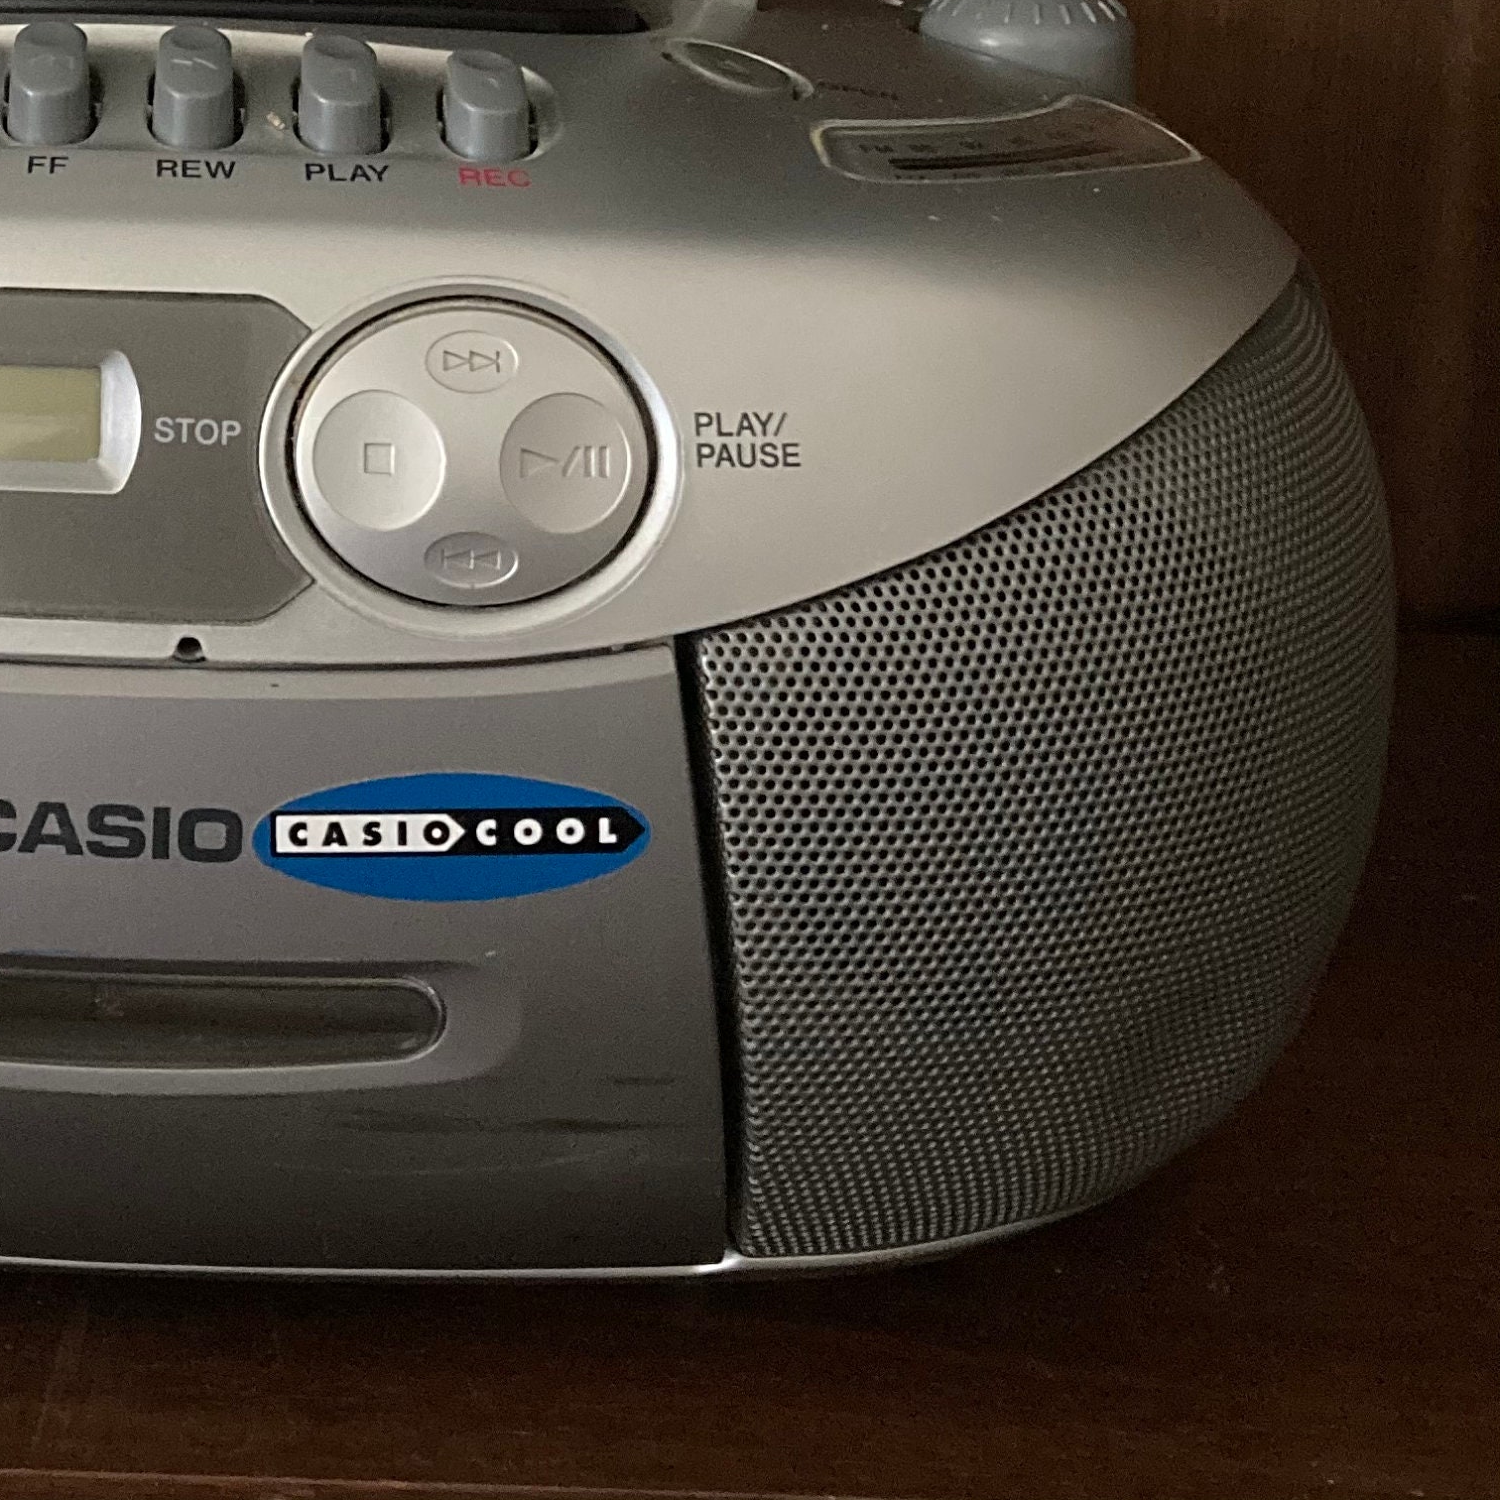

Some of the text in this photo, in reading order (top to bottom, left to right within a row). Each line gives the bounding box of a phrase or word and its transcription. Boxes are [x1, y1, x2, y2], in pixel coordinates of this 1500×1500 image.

[27, 156, 69, 174] FF
[155, 159, 236, 179] REW
[305, 163, 390, 182] PLAY
[458, 167, 532, 188] REC
[153, 416, 242, 446] STOP
[694, 411, 787, 438] PLAY/
[697, 442, 802, 469] PAUSE
[288, 817, 617, 848] CASIO COOL
